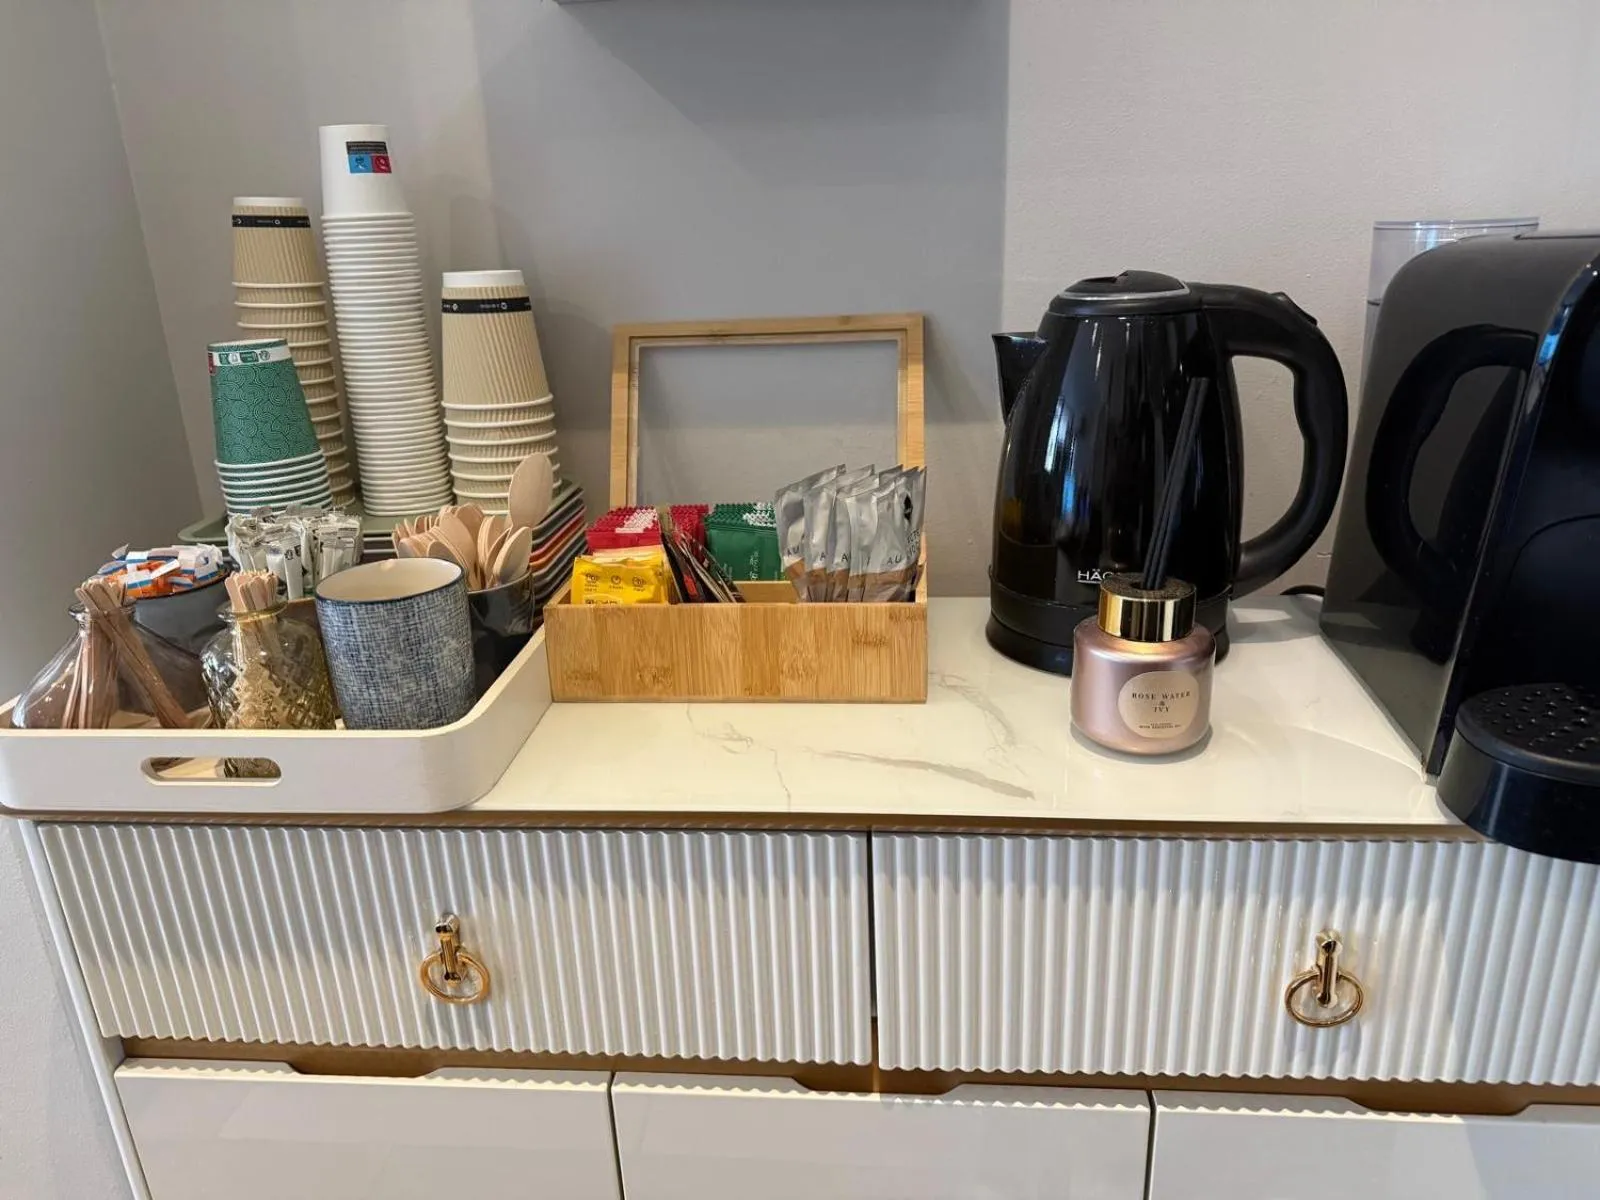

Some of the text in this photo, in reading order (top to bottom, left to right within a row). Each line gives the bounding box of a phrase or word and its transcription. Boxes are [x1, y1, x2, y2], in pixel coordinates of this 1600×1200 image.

[1132, 691, 1190, 700] ROSE WATER
[1154, 705, 1169, 713] IVY
